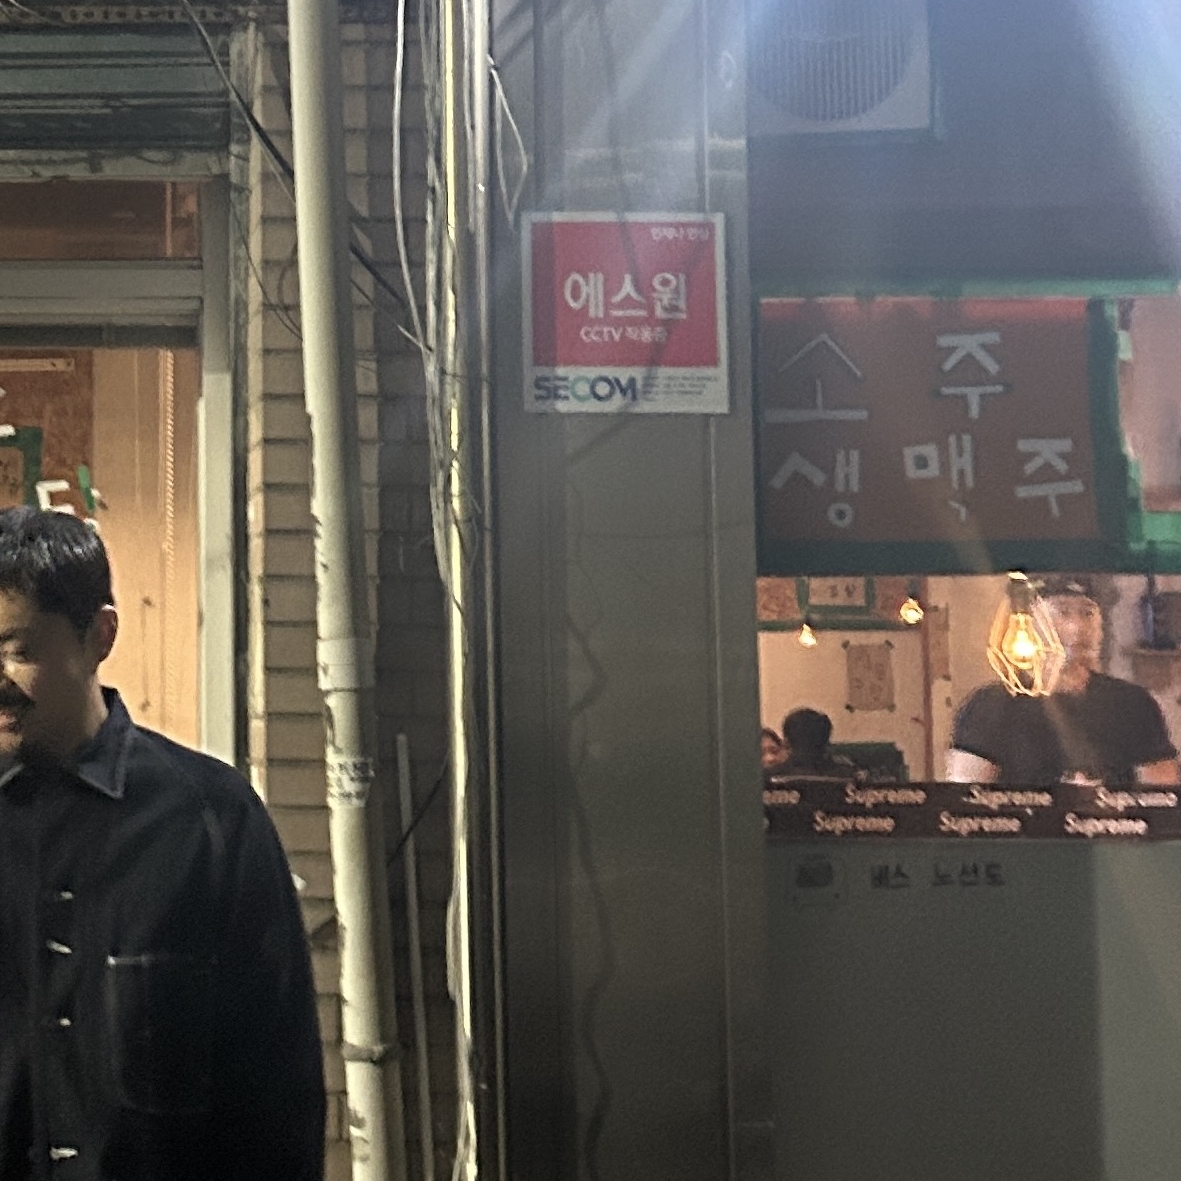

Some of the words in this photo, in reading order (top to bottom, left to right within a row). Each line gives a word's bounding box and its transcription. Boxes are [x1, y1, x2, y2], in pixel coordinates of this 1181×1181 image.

[564, 271, 687, 320] 에스원
[580, 326, 623, 342] CCTV
[533, 375, 638, 402] SECOM
[765, 331, 1005, 424] 소주
[769, 432, 1085, 528] 생맥주
[845, 783, 927, 808] Supreme
[969, 784, 1053, 810] Supreme
[1095, 786, 1178, 812] Supreme
[813, 810, 896, 836] Supreme
[939, 810, 1022, 837] Supreme
[1065, 812, 1149, 838] Supreme
